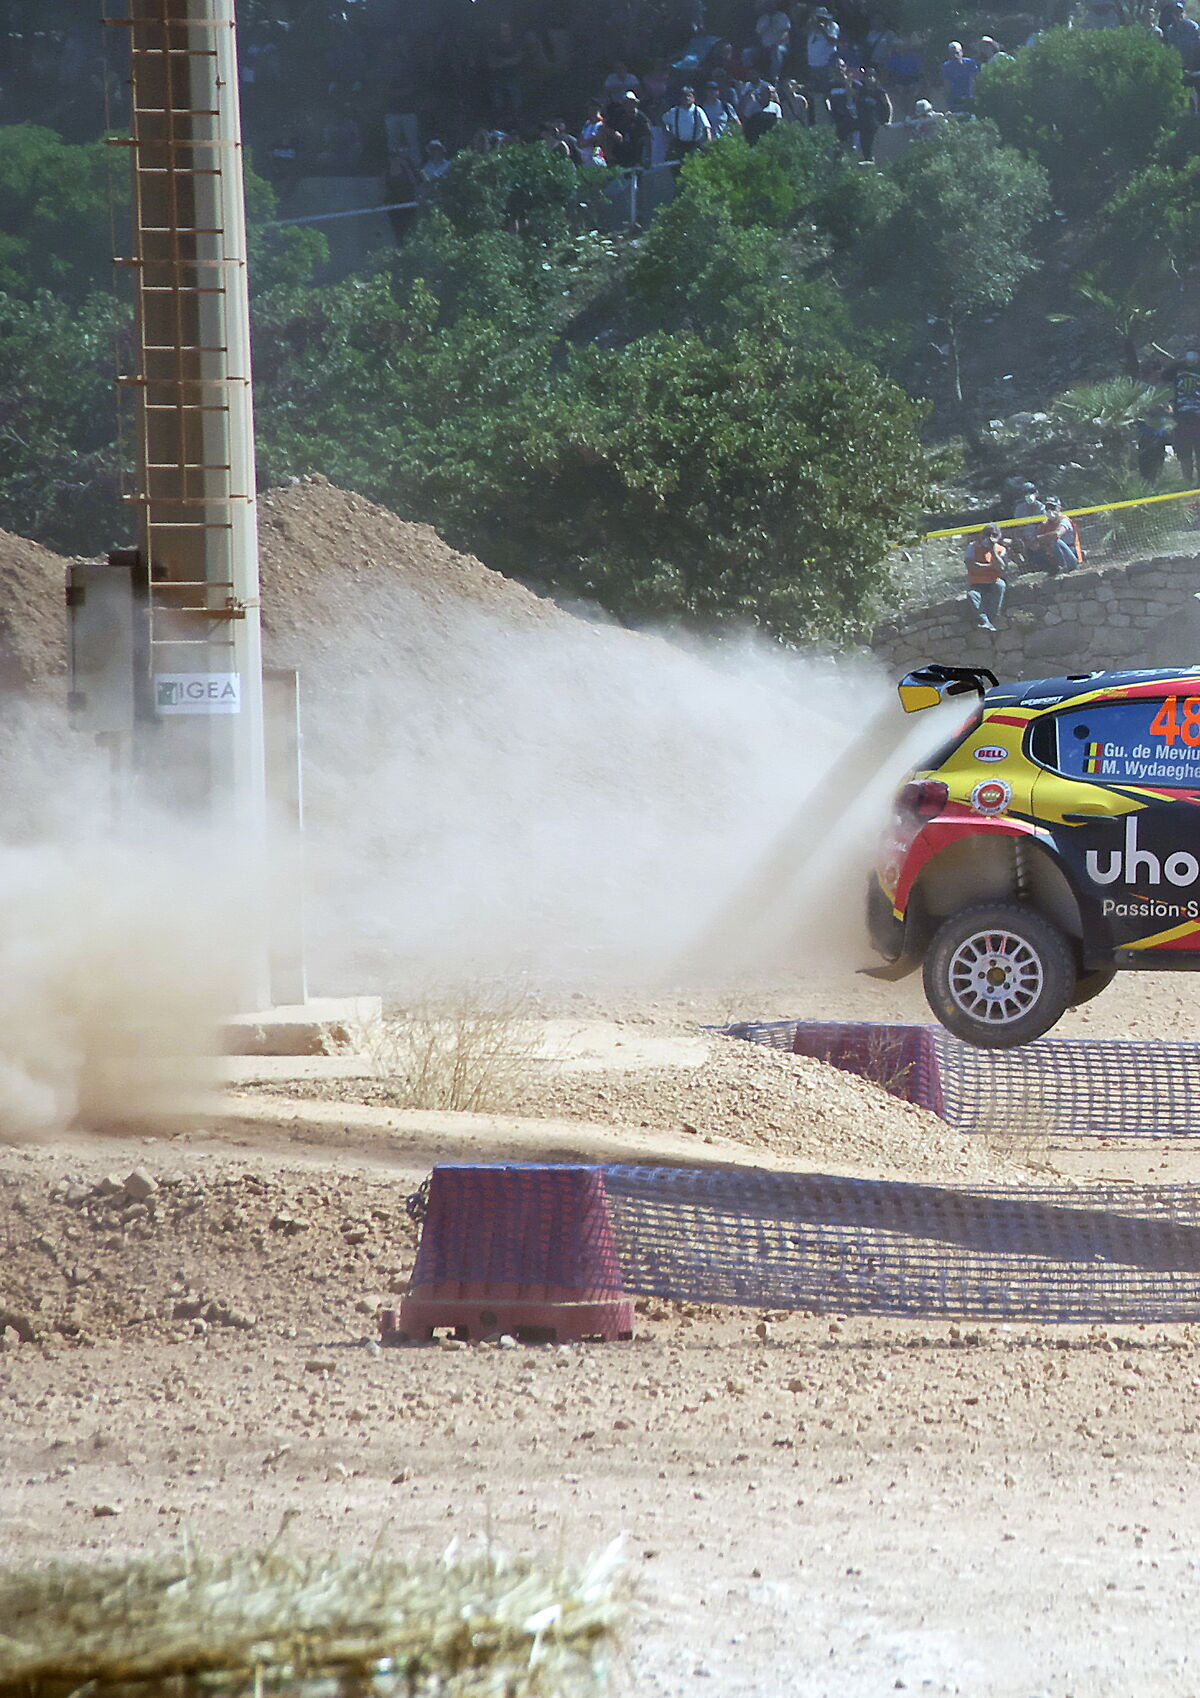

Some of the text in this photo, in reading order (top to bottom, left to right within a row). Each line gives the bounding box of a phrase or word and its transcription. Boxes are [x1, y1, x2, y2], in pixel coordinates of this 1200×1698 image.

[180, 681, 236, 698] IGEA
[977, 748, 1003, 758] BELL
[1104, 743, 1128, 758] Gu.
[1132, 744, 1151, 759] de
[1102, 760, 1120, 775] M.
[1103, 900, 1179, 917] Passion
